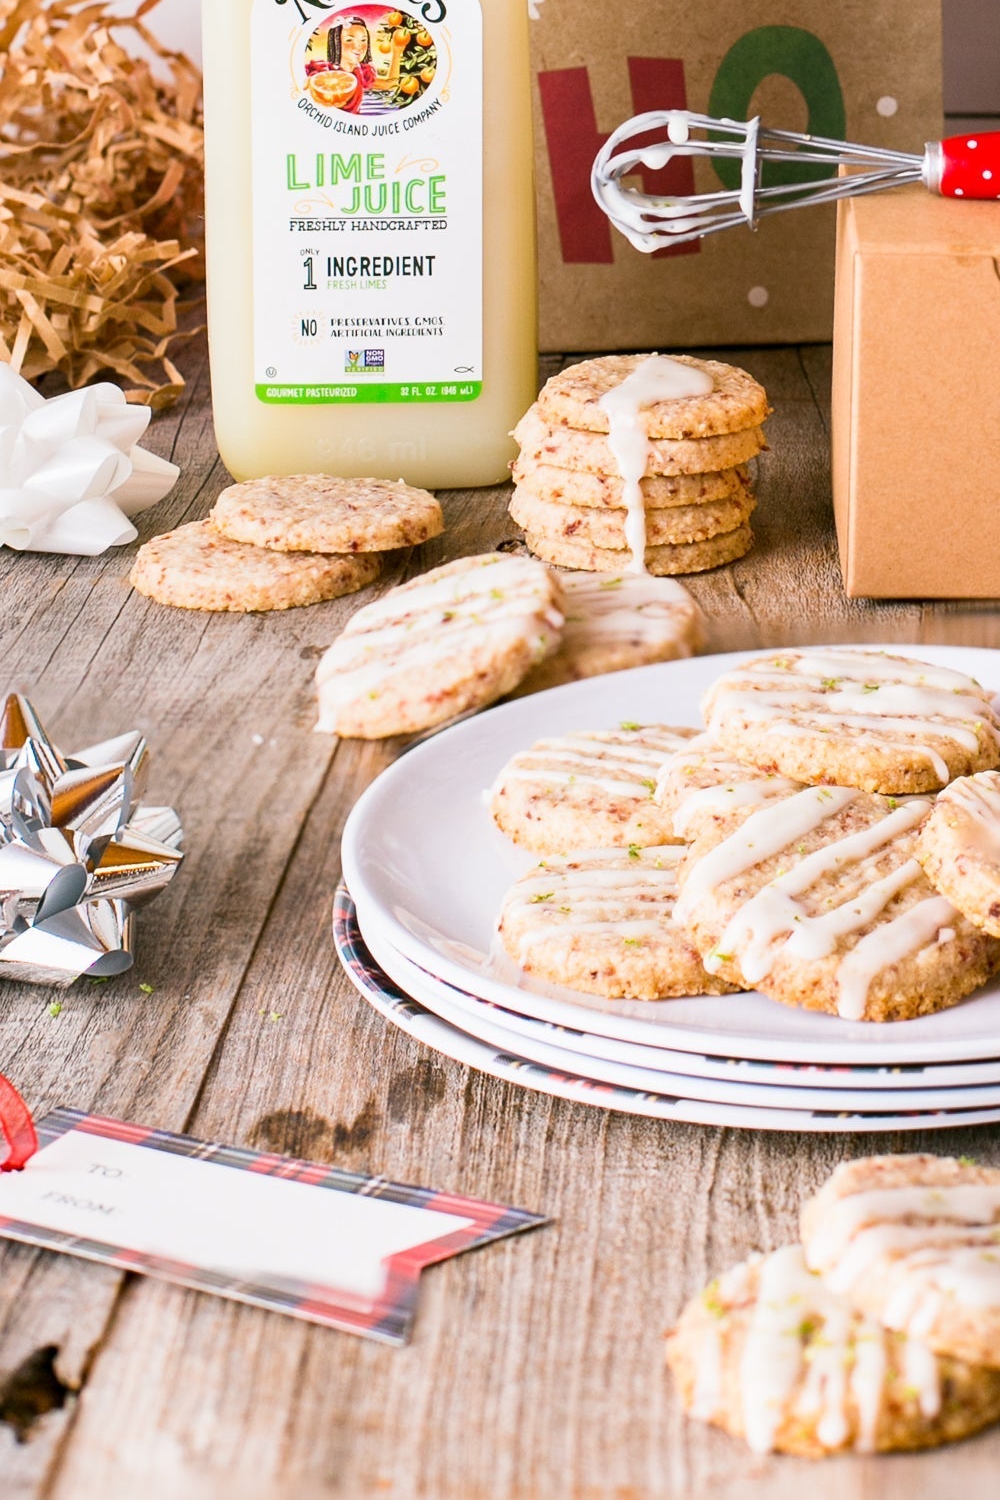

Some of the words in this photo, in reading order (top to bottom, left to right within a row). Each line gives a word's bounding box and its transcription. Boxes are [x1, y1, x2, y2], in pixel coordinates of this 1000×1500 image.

[297, 97, 333, 128] ORCHID
[333, 120, 369, 137] ISLAND
[371, 121, 400, 137] JUICE
[402, 97, 444, 132] COMPANY
[286, 153, 386, 190] LIME
[340, 175, 447, 214] JUICE
[289, 220, 347, 232] FRESHLY
[351, 219, 448, 232] HANDCRAFTED
[300, 248, 321, 256] ONLY
[303, 257, 318, 290] 1
[327, 255, 436, 277] INGREDIENT
[327, 279, 358, 290] FRESH
[359, 278, 388, 290] LIMES
[301, 319, 318, 337] NO
[330, 328, 384, 338] ARTIFICIAL
[386, 327, 443, 337] INGREDIENTS
[266, 387, 304, 398] GOURMET
[305, 386, 358, 398] PASTEURIZED
[400, 386, 409, 396] 32
